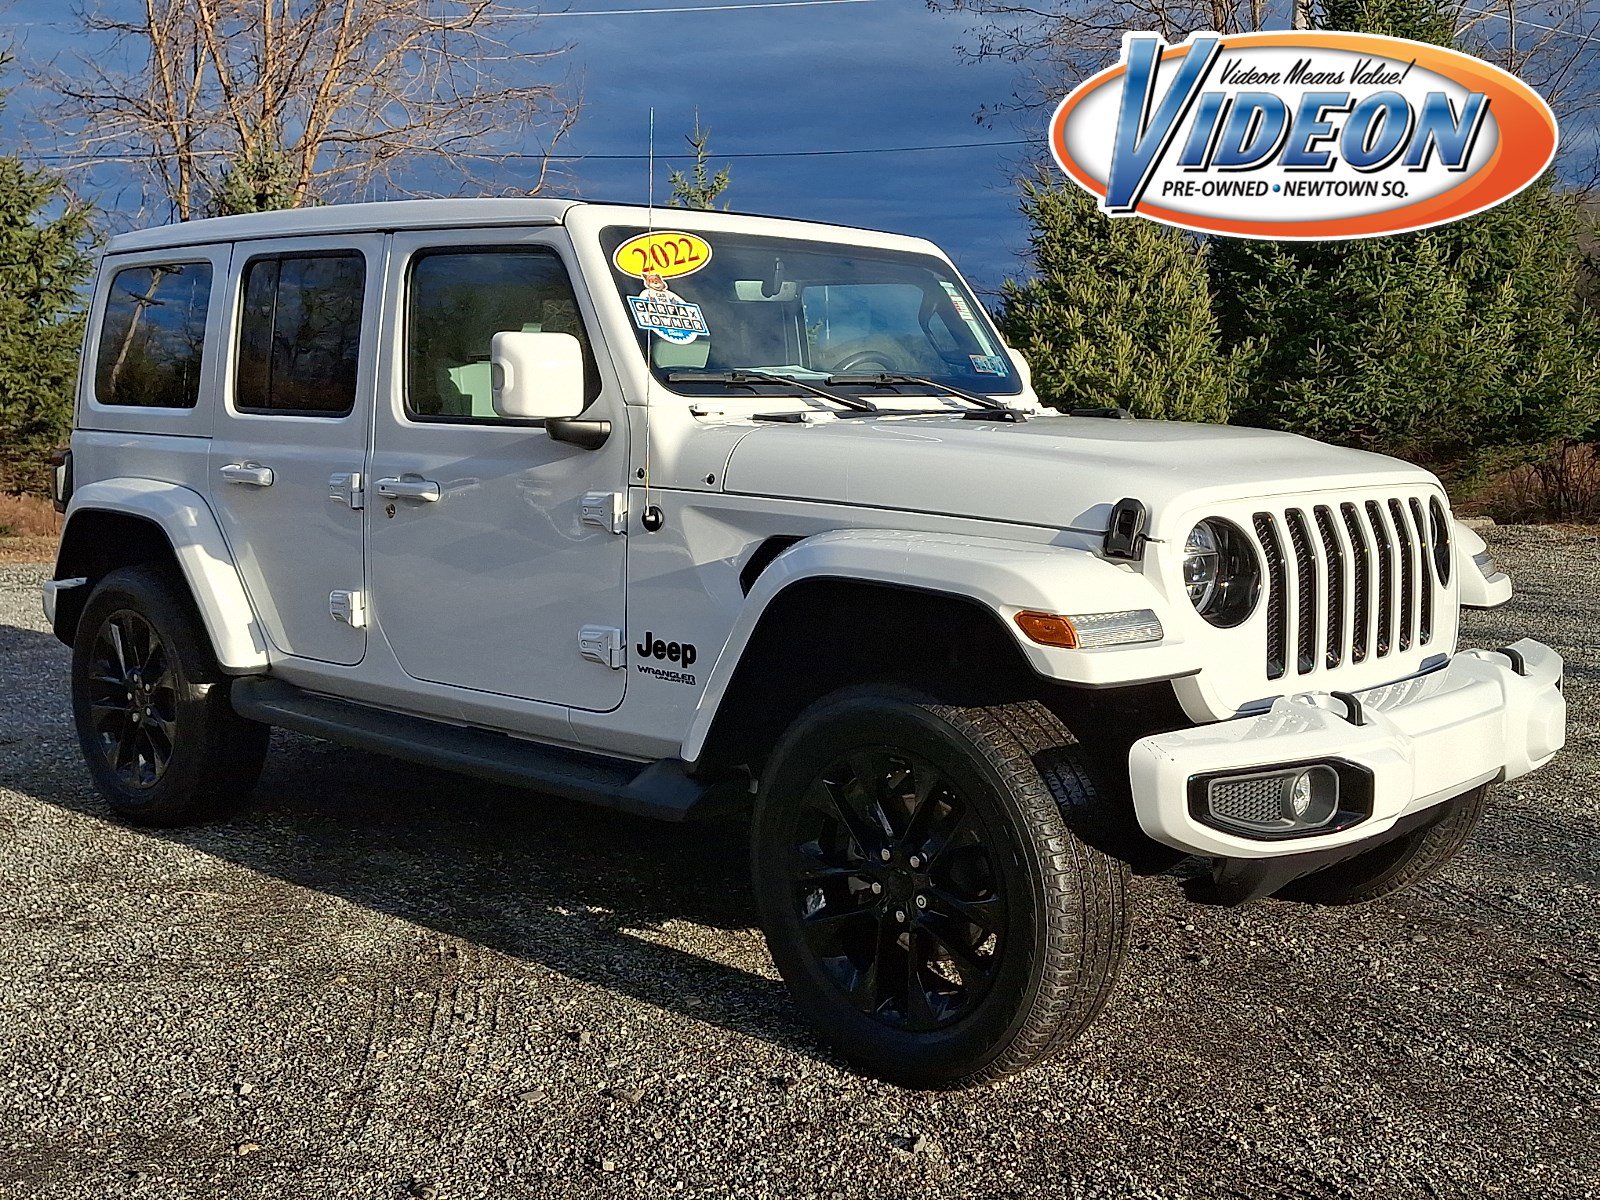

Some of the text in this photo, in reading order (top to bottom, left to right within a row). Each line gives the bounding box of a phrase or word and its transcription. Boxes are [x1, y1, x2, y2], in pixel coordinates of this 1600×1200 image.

[632, 238, 700, 273] 2022
[635, 301, 698, 319] CARFAX
[650, 315, 703, 331] OWNER
[636, 631, 697, 669] Jeep
[637, 664, 695, 681] WRANGLER
